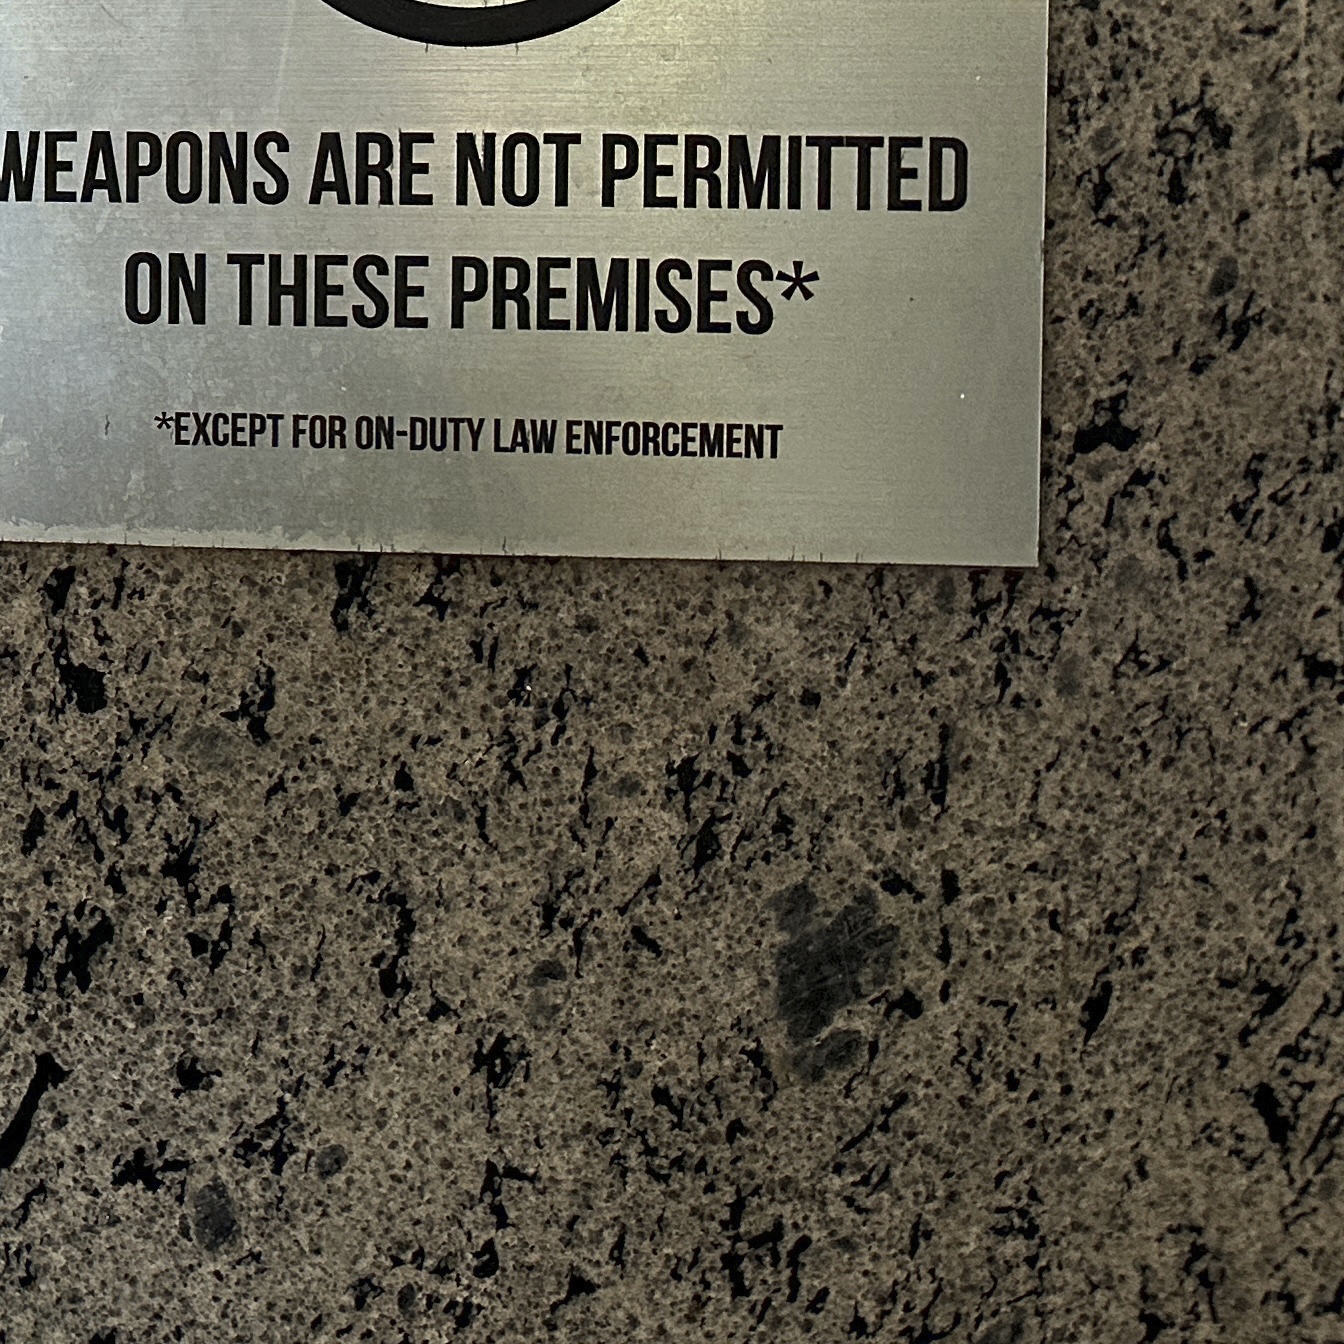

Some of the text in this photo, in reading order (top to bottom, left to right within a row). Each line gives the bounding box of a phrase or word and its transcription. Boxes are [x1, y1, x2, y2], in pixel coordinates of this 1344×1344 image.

[308, 130, 435, 207] ARE
[455, 130, 583, 208] NOT
[601, 132, 970, 213] PERMITTED
[124, 251, 207, 327] ON
[226, 253, 431, 330] THESE
[292, 413, 348, 450] FOR
[355, 414, 486, 453] ON-DUTY
[493, 416, 559, 454] LAW
[565, 418, 785, 460] ENFORCEMENT
